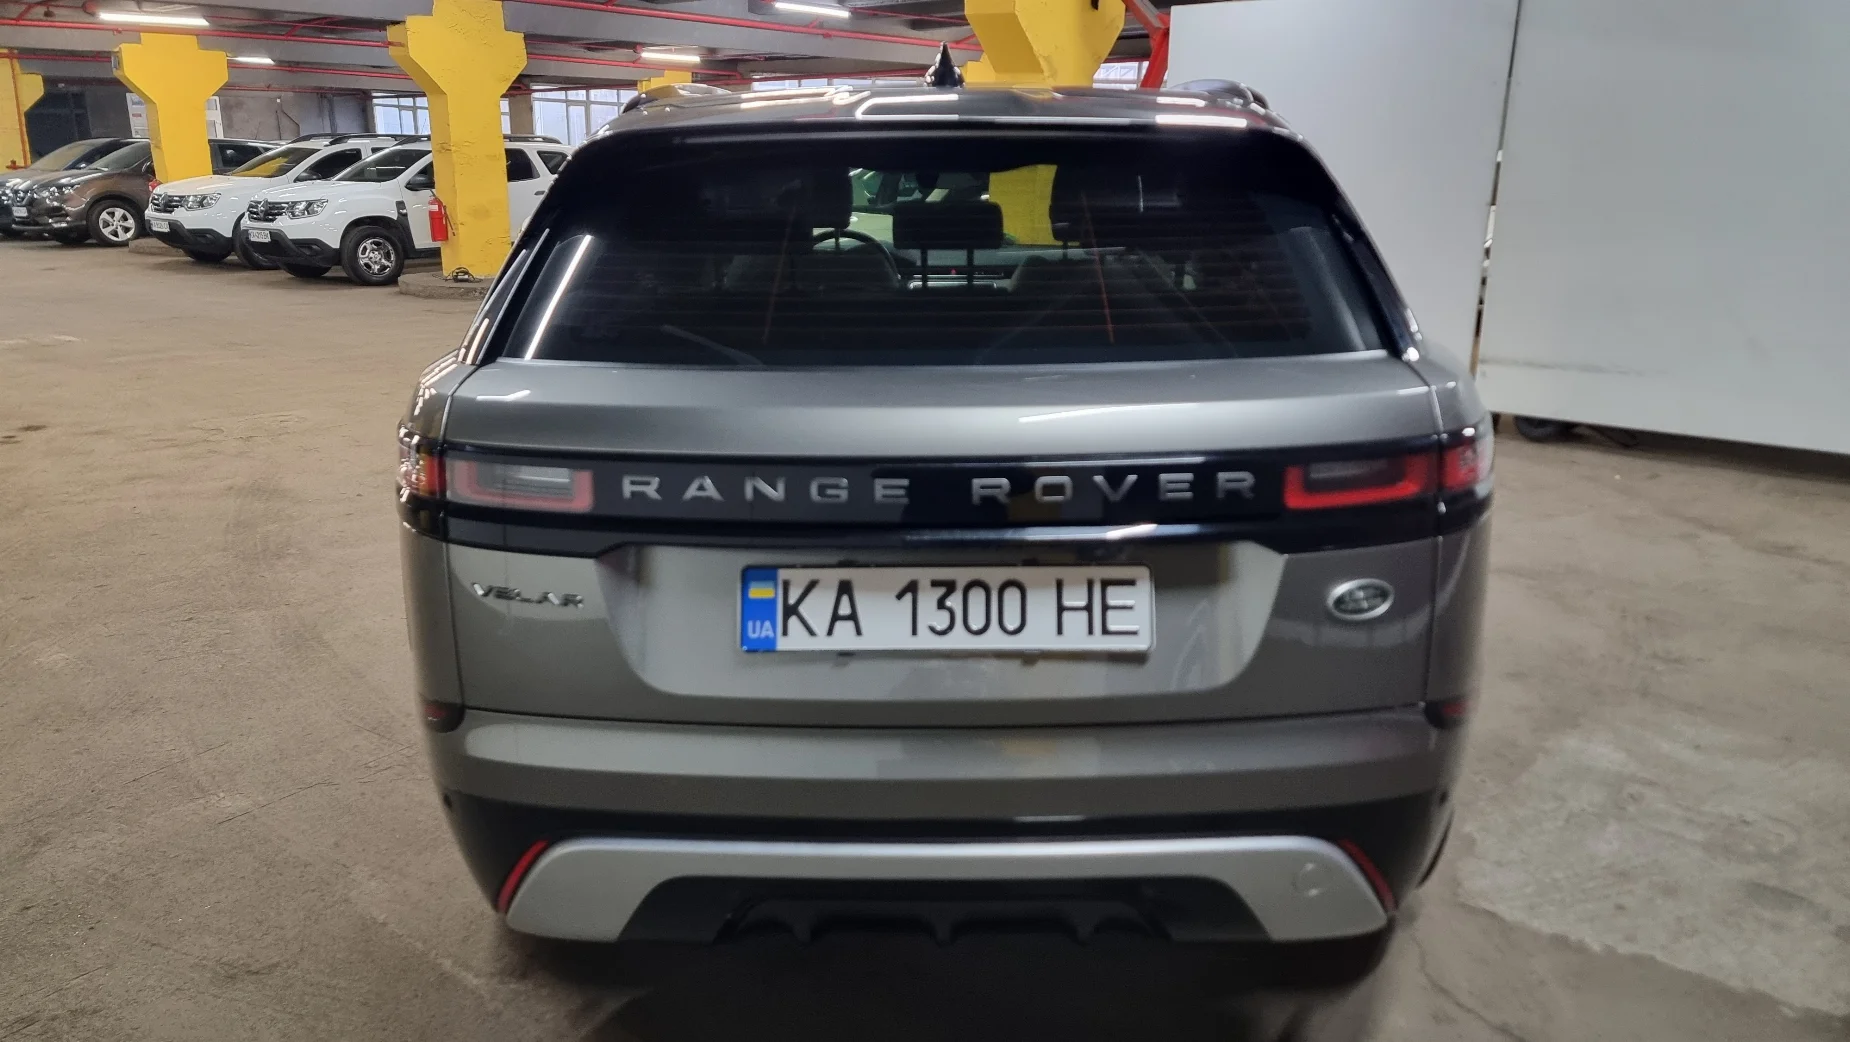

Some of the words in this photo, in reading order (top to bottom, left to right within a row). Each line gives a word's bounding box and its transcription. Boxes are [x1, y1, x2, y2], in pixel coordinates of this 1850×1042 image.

[621, 475, 910, 504] RANGE
[971, 471, 1256, 505] ROVER
[782, 579, 863, 637] KA
[895, 578, 1027, 637] 1300
[1056, 578, 1140, 636] HE
[747, 620, 775, 639] UA
